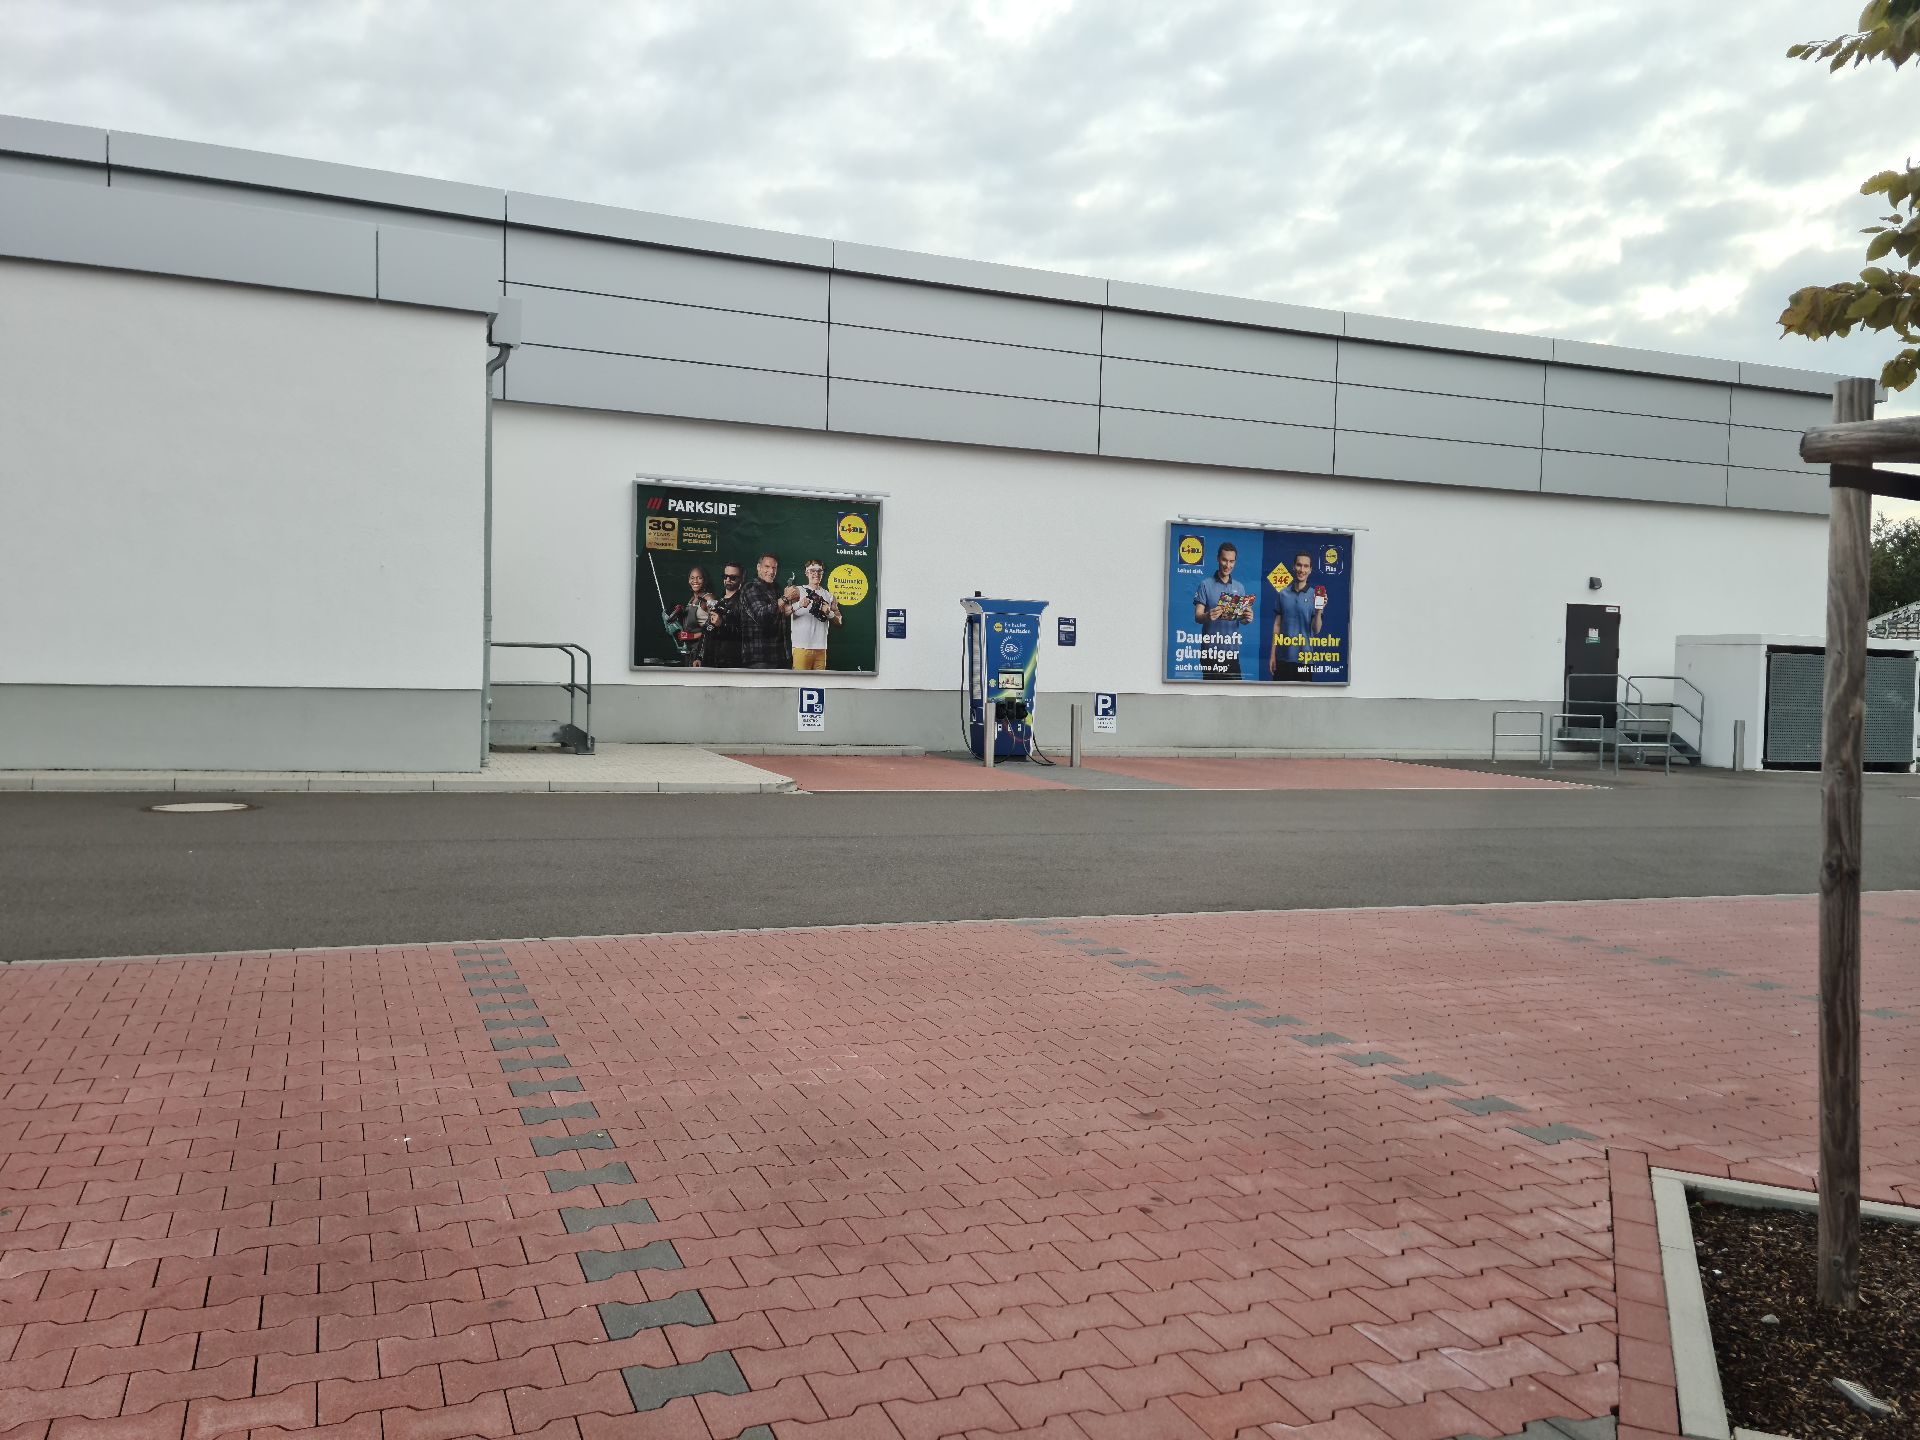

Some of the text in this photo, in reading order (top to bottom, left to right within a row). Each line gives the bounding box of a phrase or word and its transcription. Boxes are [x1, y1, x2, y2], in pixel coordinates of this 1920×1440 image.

[668, 499, 737, 516] PARKSIDE
[648, 520, 675, 532] 30
[1176, 629, 1243, 645] Dauerhaft
[1274, 633, 1341, 647] Noch mehr
[1175, 645, 1240, 663] günstiger
[1298, 650, 1340, 665] sparen
[1175, 662, 1193, 671] auch
[1194, 663, 1212, 671] ohne
[1297, 665, 1310, 673] mit
[1310, 665, 1324, 673] Lidl
[802, 690, 819, 712] P
[1097, 694, 1112, 716] P
